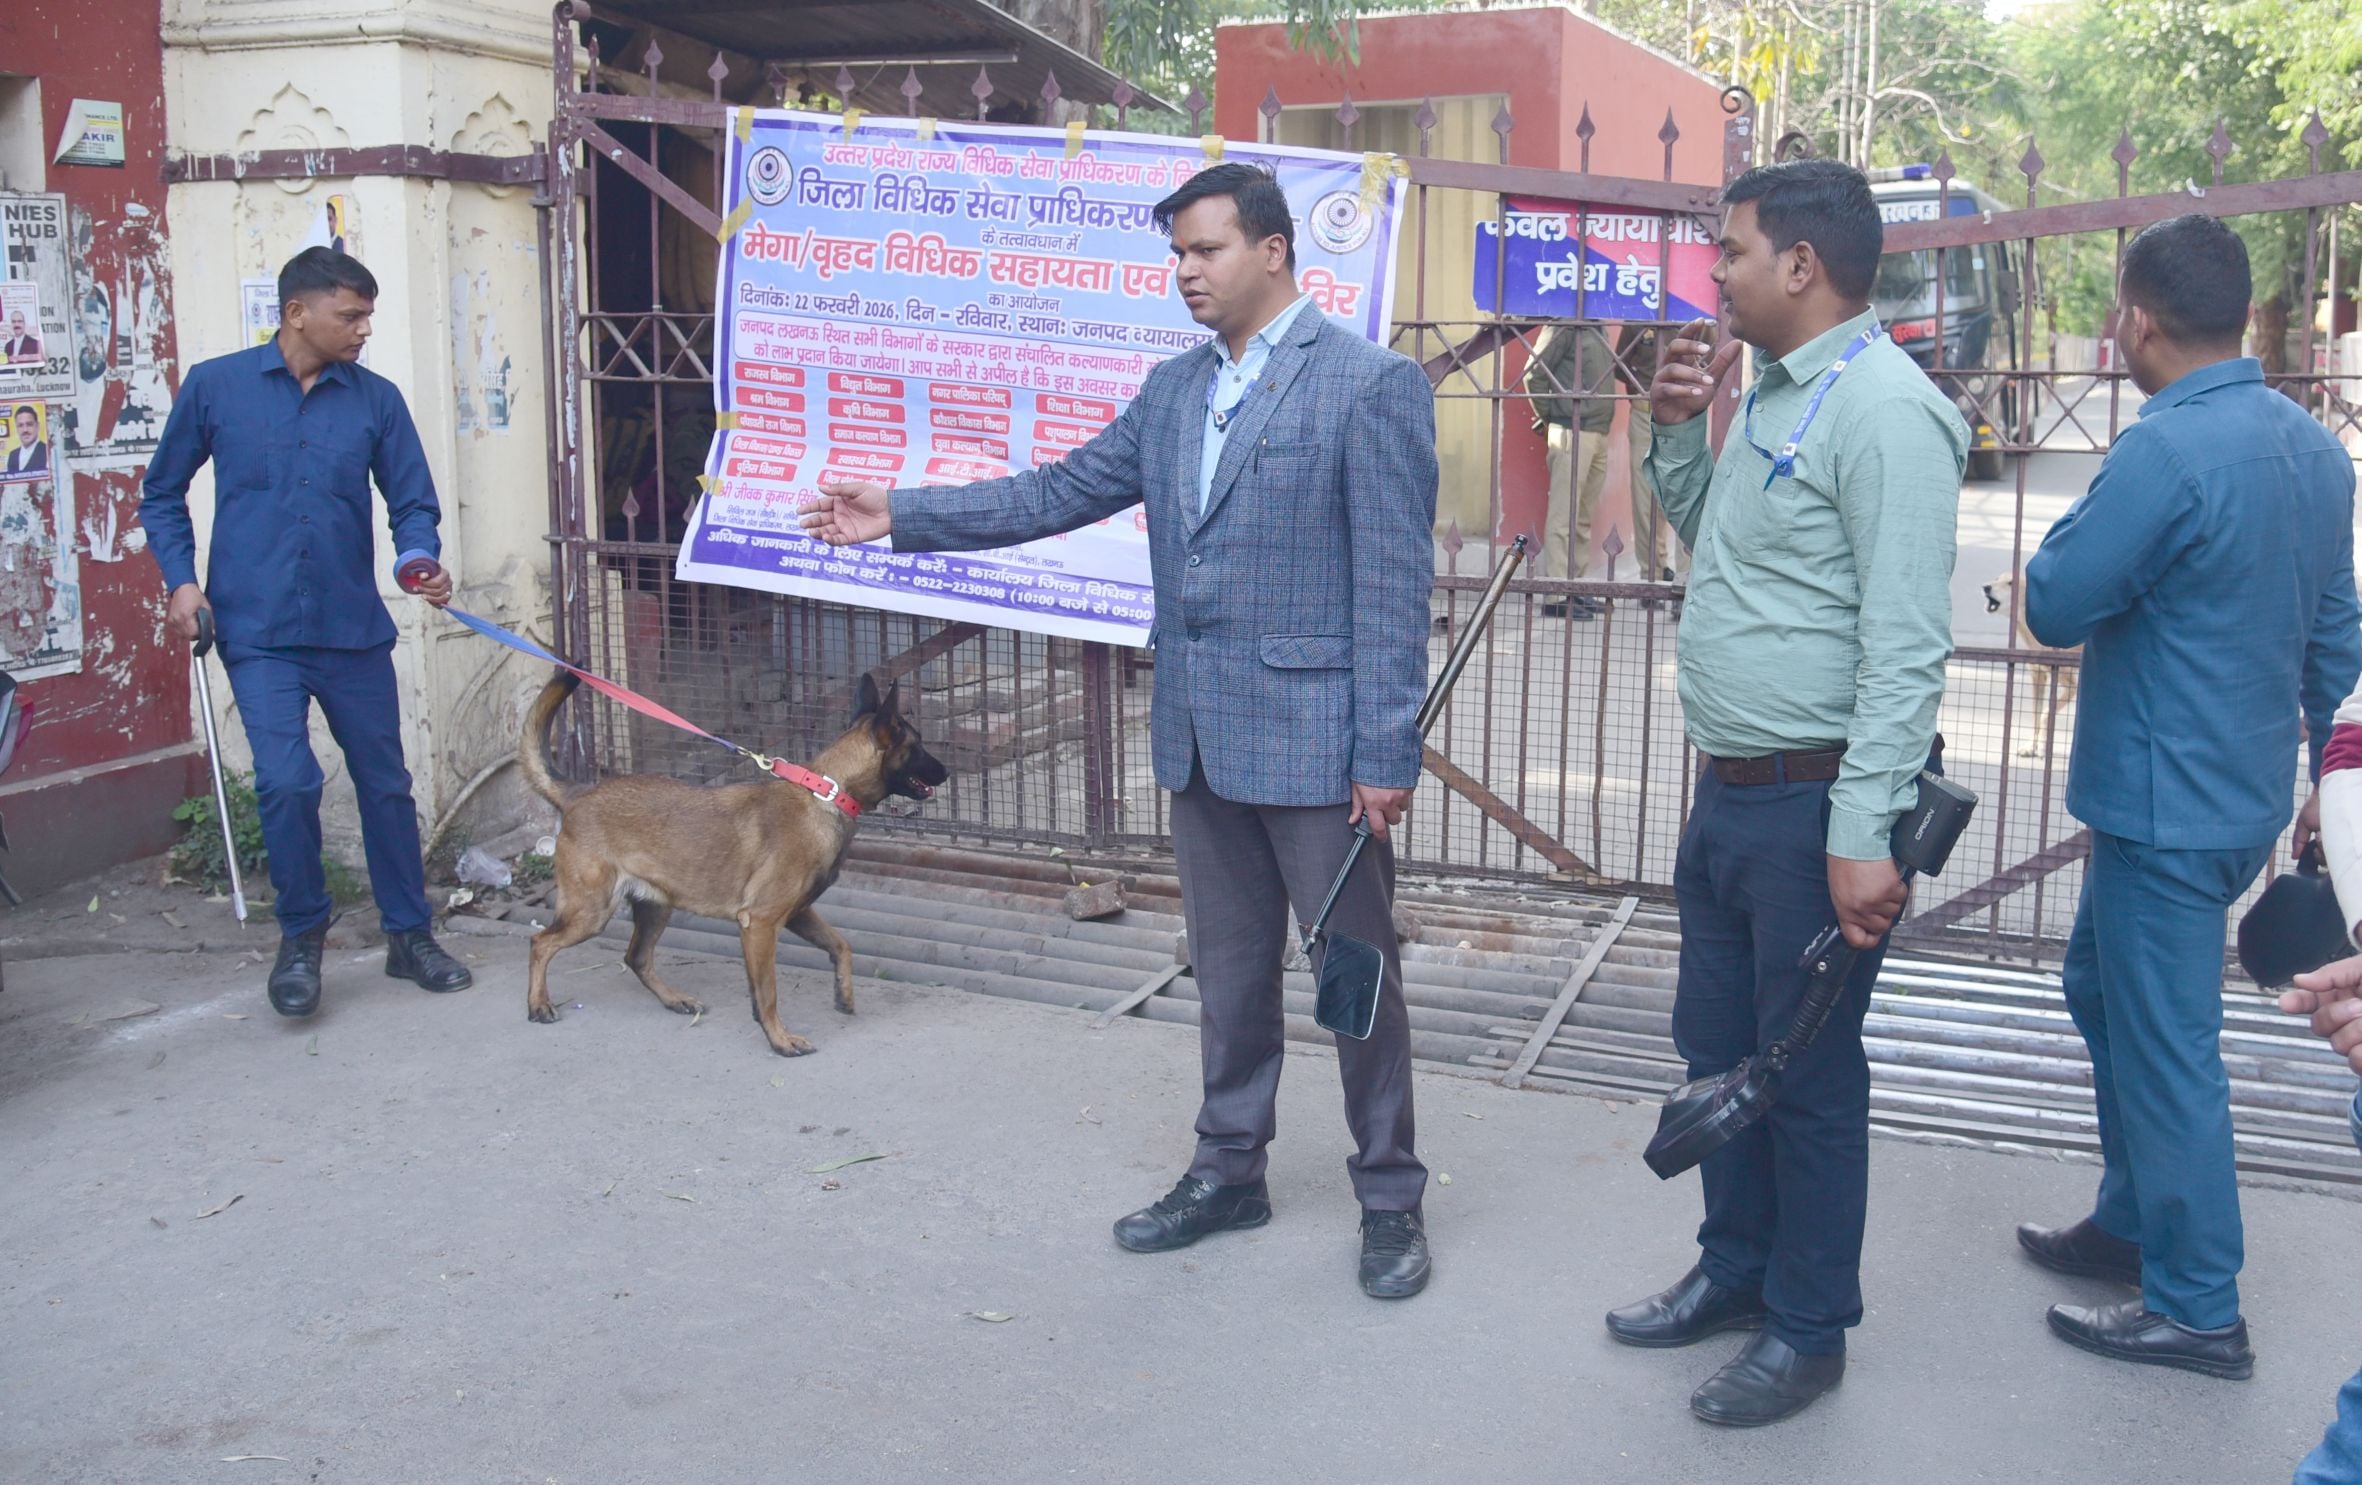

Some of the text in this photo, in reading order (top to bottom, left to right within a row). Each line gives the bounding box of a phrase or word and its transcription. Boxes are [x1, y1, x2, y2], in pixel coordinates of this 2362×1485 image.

[82, 131, 115, 142] AKIR
[823, 143, 867, 168] उत्तर
[872, 144, 913, 170] प्रदेश
[917, 148, 956, 172] राज्य
[962, 146, 1015, 176] विधिक
[1020, 151, 1055, 178] सेवा
[1059, 153, 1141, 185] प्राधिकरण
[1147, 160, 1168, 186] के
[799, 168, 866, 208] जिला
[874, 174, 960, 216] विधिक
[967, 182, 1021, 220] सेवा
[9, 224, 58, 239] HUB
[981, 227, 996, 244] के
[1066, 233, 1081, 251] में
[885, 233, 982, 277] विधिक
[990, 252, 1114, 292] सहायता
[1122, 257, 1177, 297] एवं
[1301, 269, 1360, 315] विर
[1535, 252, 1661, 309] प्रवेश हेतु
[794, 294, 808, 310] 22
[813, 293, 860, 316] फरवरी
[864, 301, 899, 321] 2026,
[906, 300, 936, 324] दिन
[955, 305, 1012, 332] रविवार,
[1018, 316, 1065, 335] स्थान:
[1072, 320, 1128, 341] जनपद
[988, 292, 1060, 312] का आयोजन
[740, 318, 775, 337] जनपद
[778, 320, 819, 341] लखनऊ
[823, 322, 850, 345] स्थित
[854, 327, 878, 347] सभी
[881, 328, 924, 352] विभागों
[926, 334, 939, 352] के
[943, 339, 985, 360] सरकार
[988, 343, 1011, 363] द्वारा
[1015, 343, 1064, 367] संचालित
[1068, 350, 1143, 376] कल्याणकारी
[753, 342, 769, 358] को
[772, 345, 793, 360] लाभ
[797, 348, 826, 366] प्रदान
[829, 346, 857, 369] किया
[908, 360, 933, 377] आप
[936, 359, 962, 379] सभी
[966, 363, 978, 380] से
[981, 361, 1018, 385] अपील
[1020, 366, 1032, 388] है
[1033, 367, 1050, 388] कि
[1054, 374, 1074, 394] इस
[1077, 377, 1119, 398] अवसर
[707, 529, 748, 546] अधिक
[751, 533, 811, 554] जानकारी
[814, 540, 831, 556] के
[832, 544, 863, 562] लिए
[866, 549, 914, 569] सम्पर्क
[967, 564, 1034, 587] कार्यालय
[1038, 573, 1081, 595] जिला
[1085, 581, 1139, 602] विधिक
[779, 555, 820, 571] अथवा
[824, 560, 855, 577] फोन
[1059, 596, 1087, 613] बजे
[1091, 599, 1109, 614] से
[1112, 604, 1152, 621] 05:00
